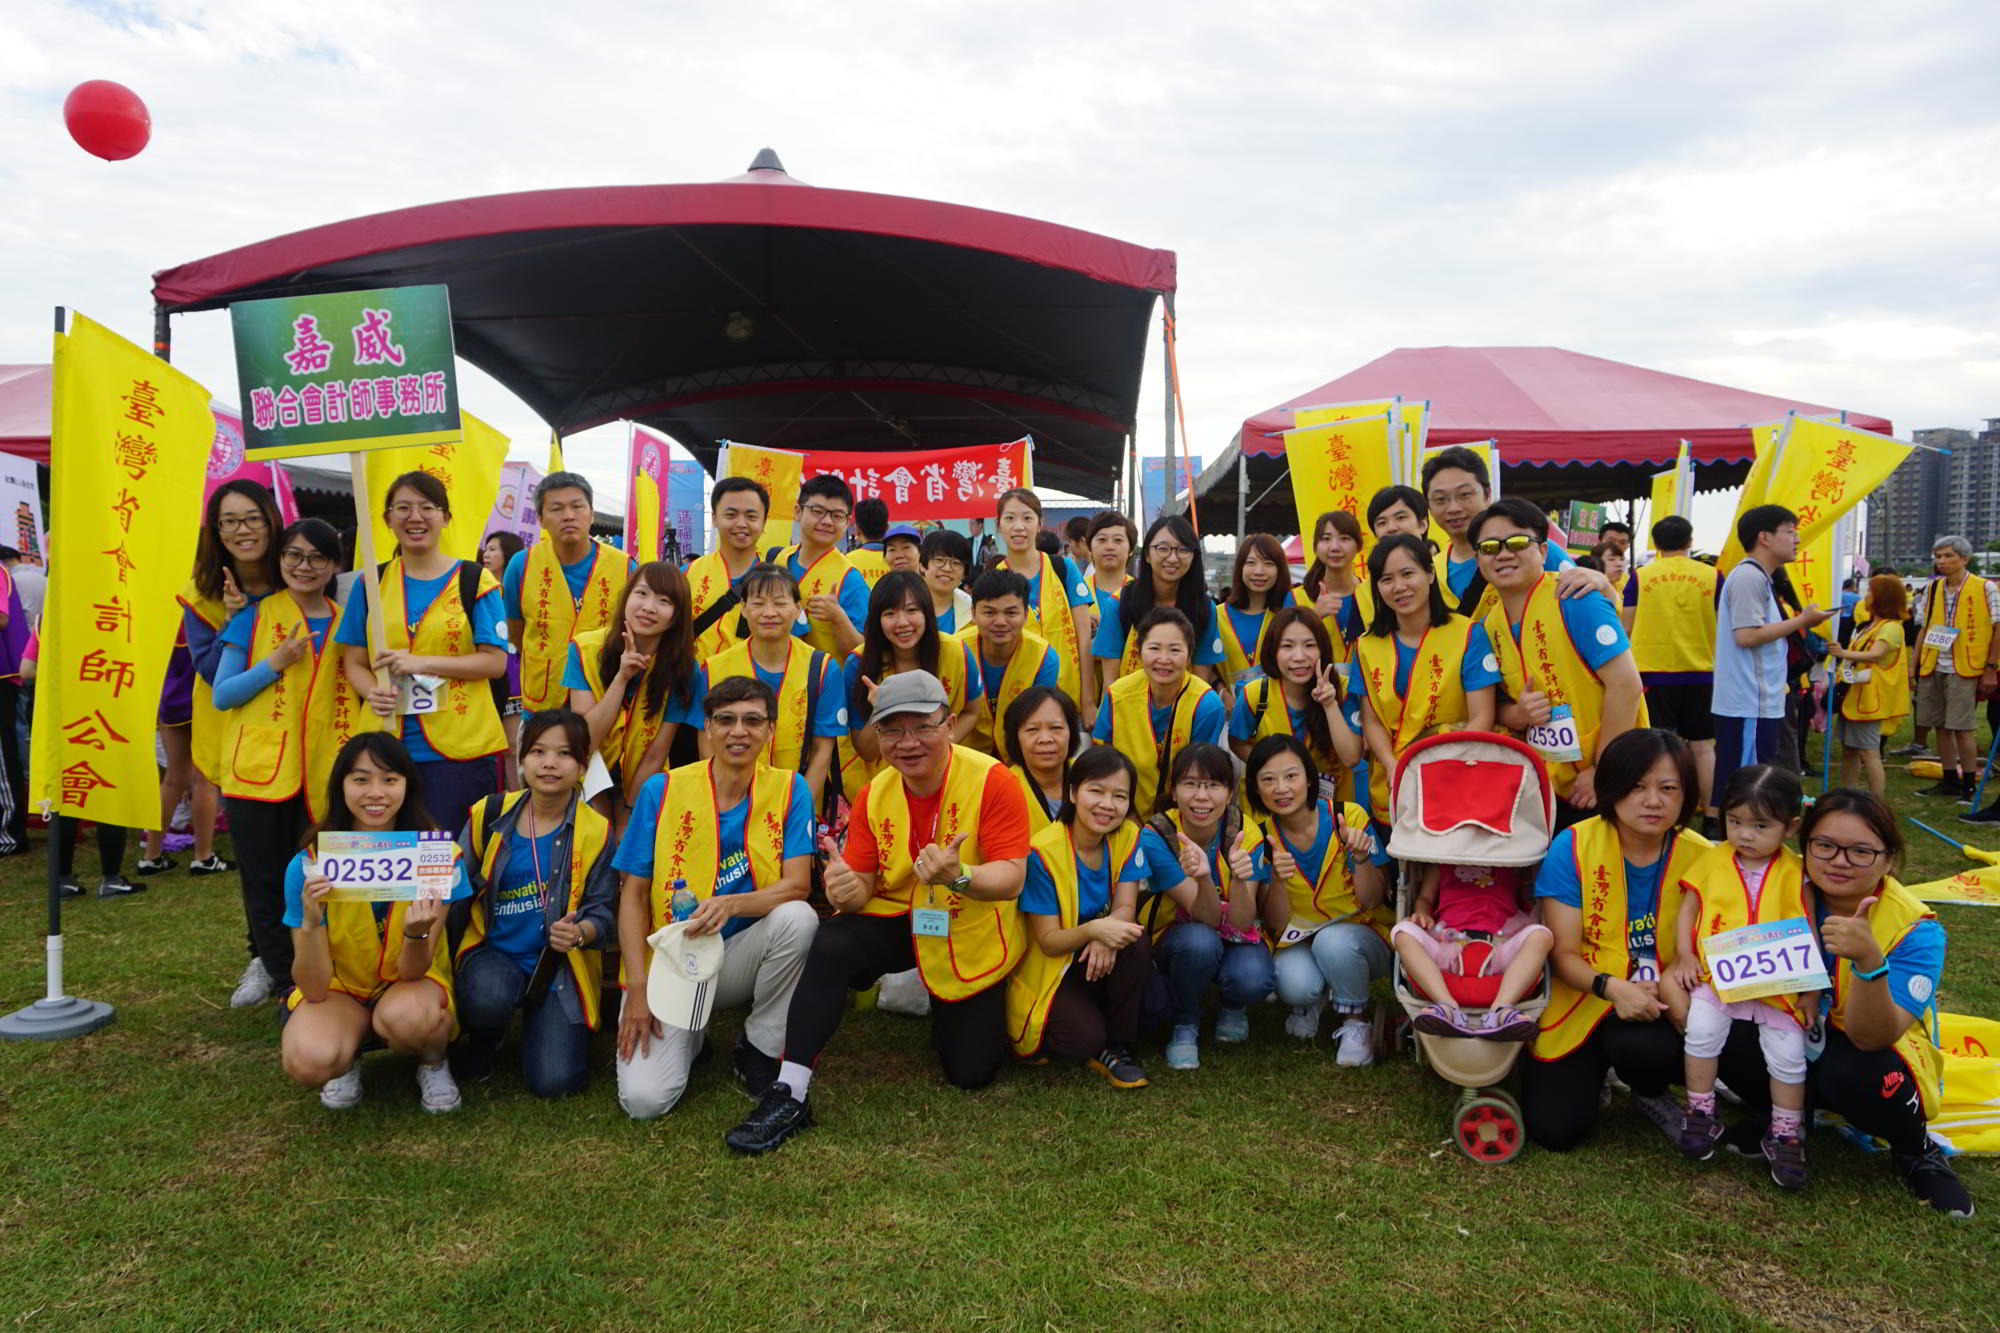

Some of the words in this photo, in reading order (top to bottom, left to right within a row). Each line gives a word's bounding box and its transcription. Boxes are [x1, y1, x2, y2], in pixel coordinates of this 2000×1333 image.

[285, 309, 404, 375] 嘉威
[251, 371, 446, 430] 聯合會計師事務所
[61, 379, 165, 808] 臺灣省會計師公會
[324, 858, 413, 882] 02532
[420, 854, 451, 863] 02532
[1716, 944, 1811, 983] 02517
